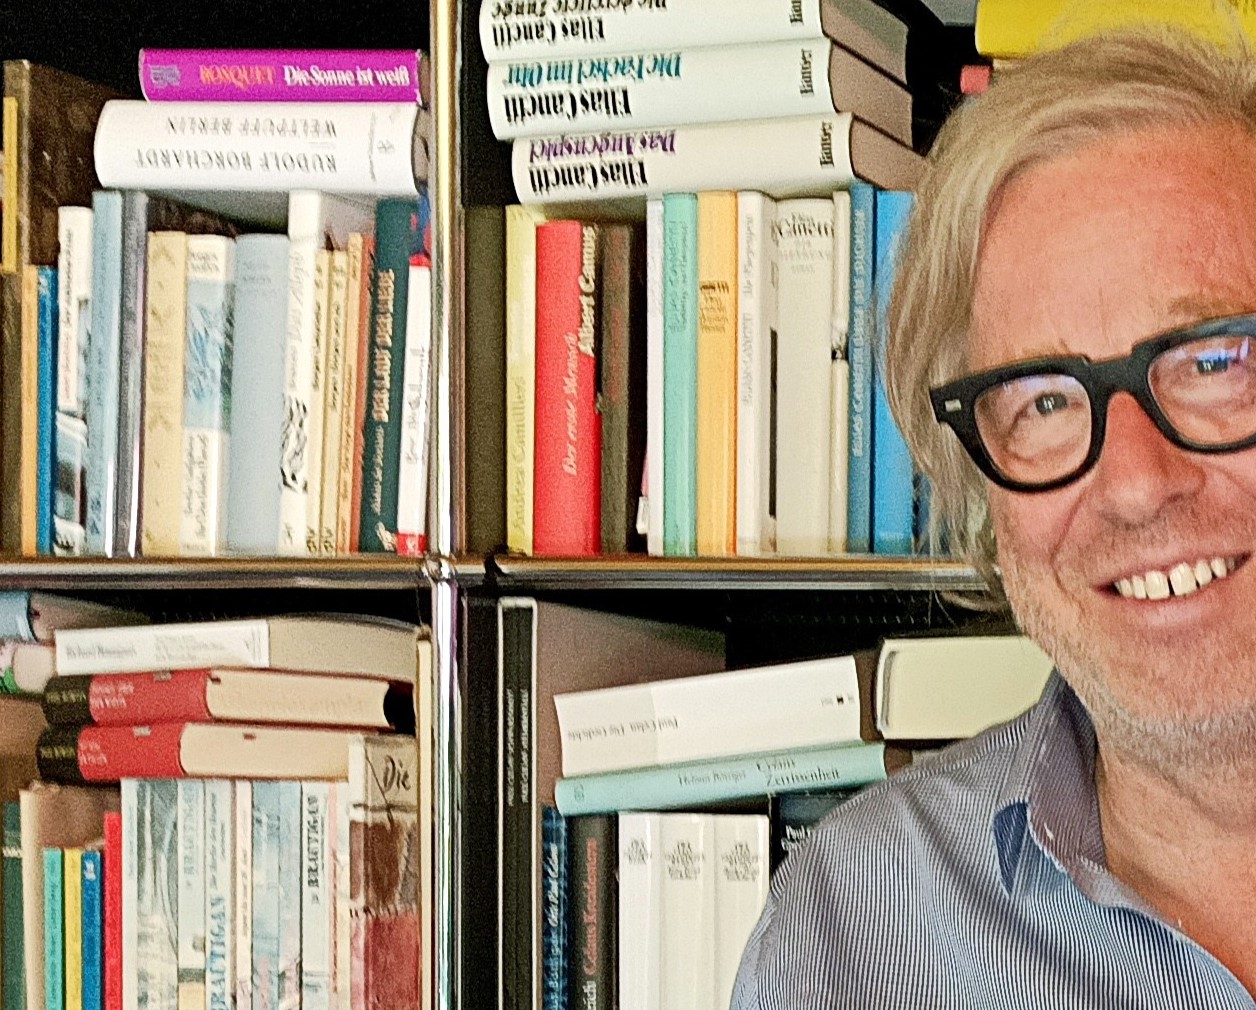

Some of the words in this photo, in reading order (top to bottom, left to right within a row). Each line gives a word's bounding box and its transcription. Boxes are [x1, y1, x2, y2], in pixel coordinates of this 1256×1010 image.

[492, 20, 557, 50] Canetti
[561, 16, 605, 44] Elias
[200, 65, 275, 89] BOSQUET
[284, 65, 308, 86] Die
[309, 65, 355, 87] Sonne
[356, 65, 375, 86] ist
[376, 64, 411, 87] weiß
[506, 58, 543, 89] Ohr
[647, 51, 682, 81] Die
[503, 90, 578, 127] Canetti
[580, 86, 633, 121] Elias
[167, 116, 232, 137] BERLIN
[239, 117, 338, 138] WELTPUFF
[640, 129, 677, 157] Das
[134, 149, 252, 172] BORCHARDT
[260, 152, 338, 174] RUDOLF
[600, 158, 649, 190] Elias
[528, 163, 599, 196] Canetti
[578, 226, 596, 293] Camus
[577, 294, 595, 358] Albert
[381, 755, 412, 793] Die
[765, 767, 840, 788] Zerrissenheit
[306, 794, 321, 888] BRAUTIGAN
[584, 926, 598, 976] Celans
